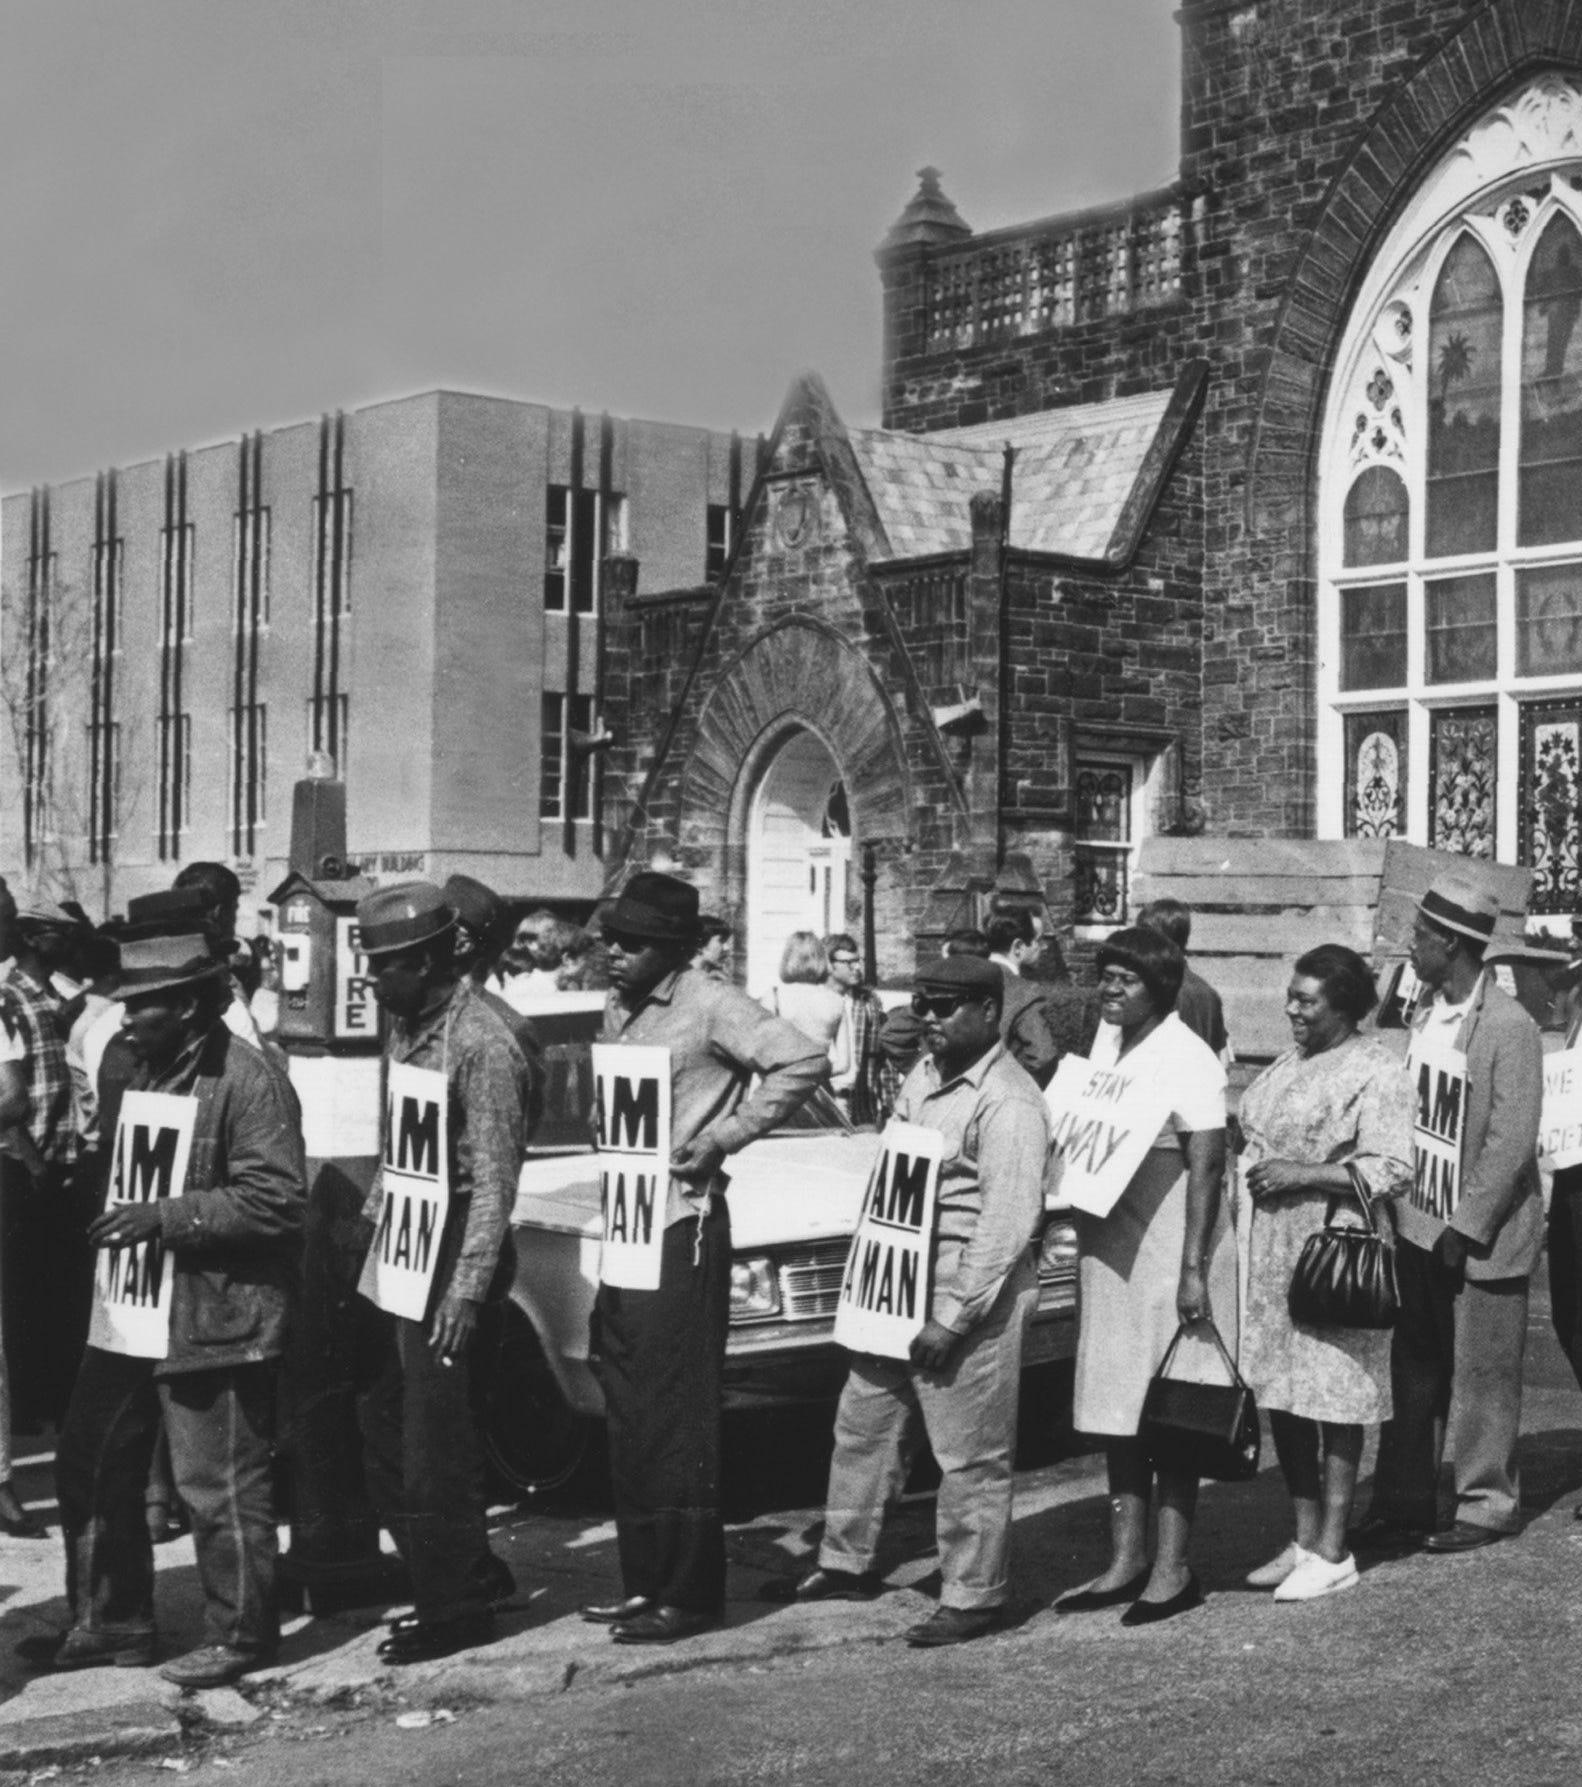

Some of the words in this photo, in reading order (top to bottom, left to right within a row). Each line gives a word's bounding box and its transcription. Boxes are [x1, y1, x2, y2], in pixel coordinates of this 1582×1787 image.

[1082, 1069, 1136, 1104] STAY
[870, 1148, 931, 1228] AM
[1410, 1145, 1456, 1220] MAN
[856, 1239, 919, 1320] MAN
